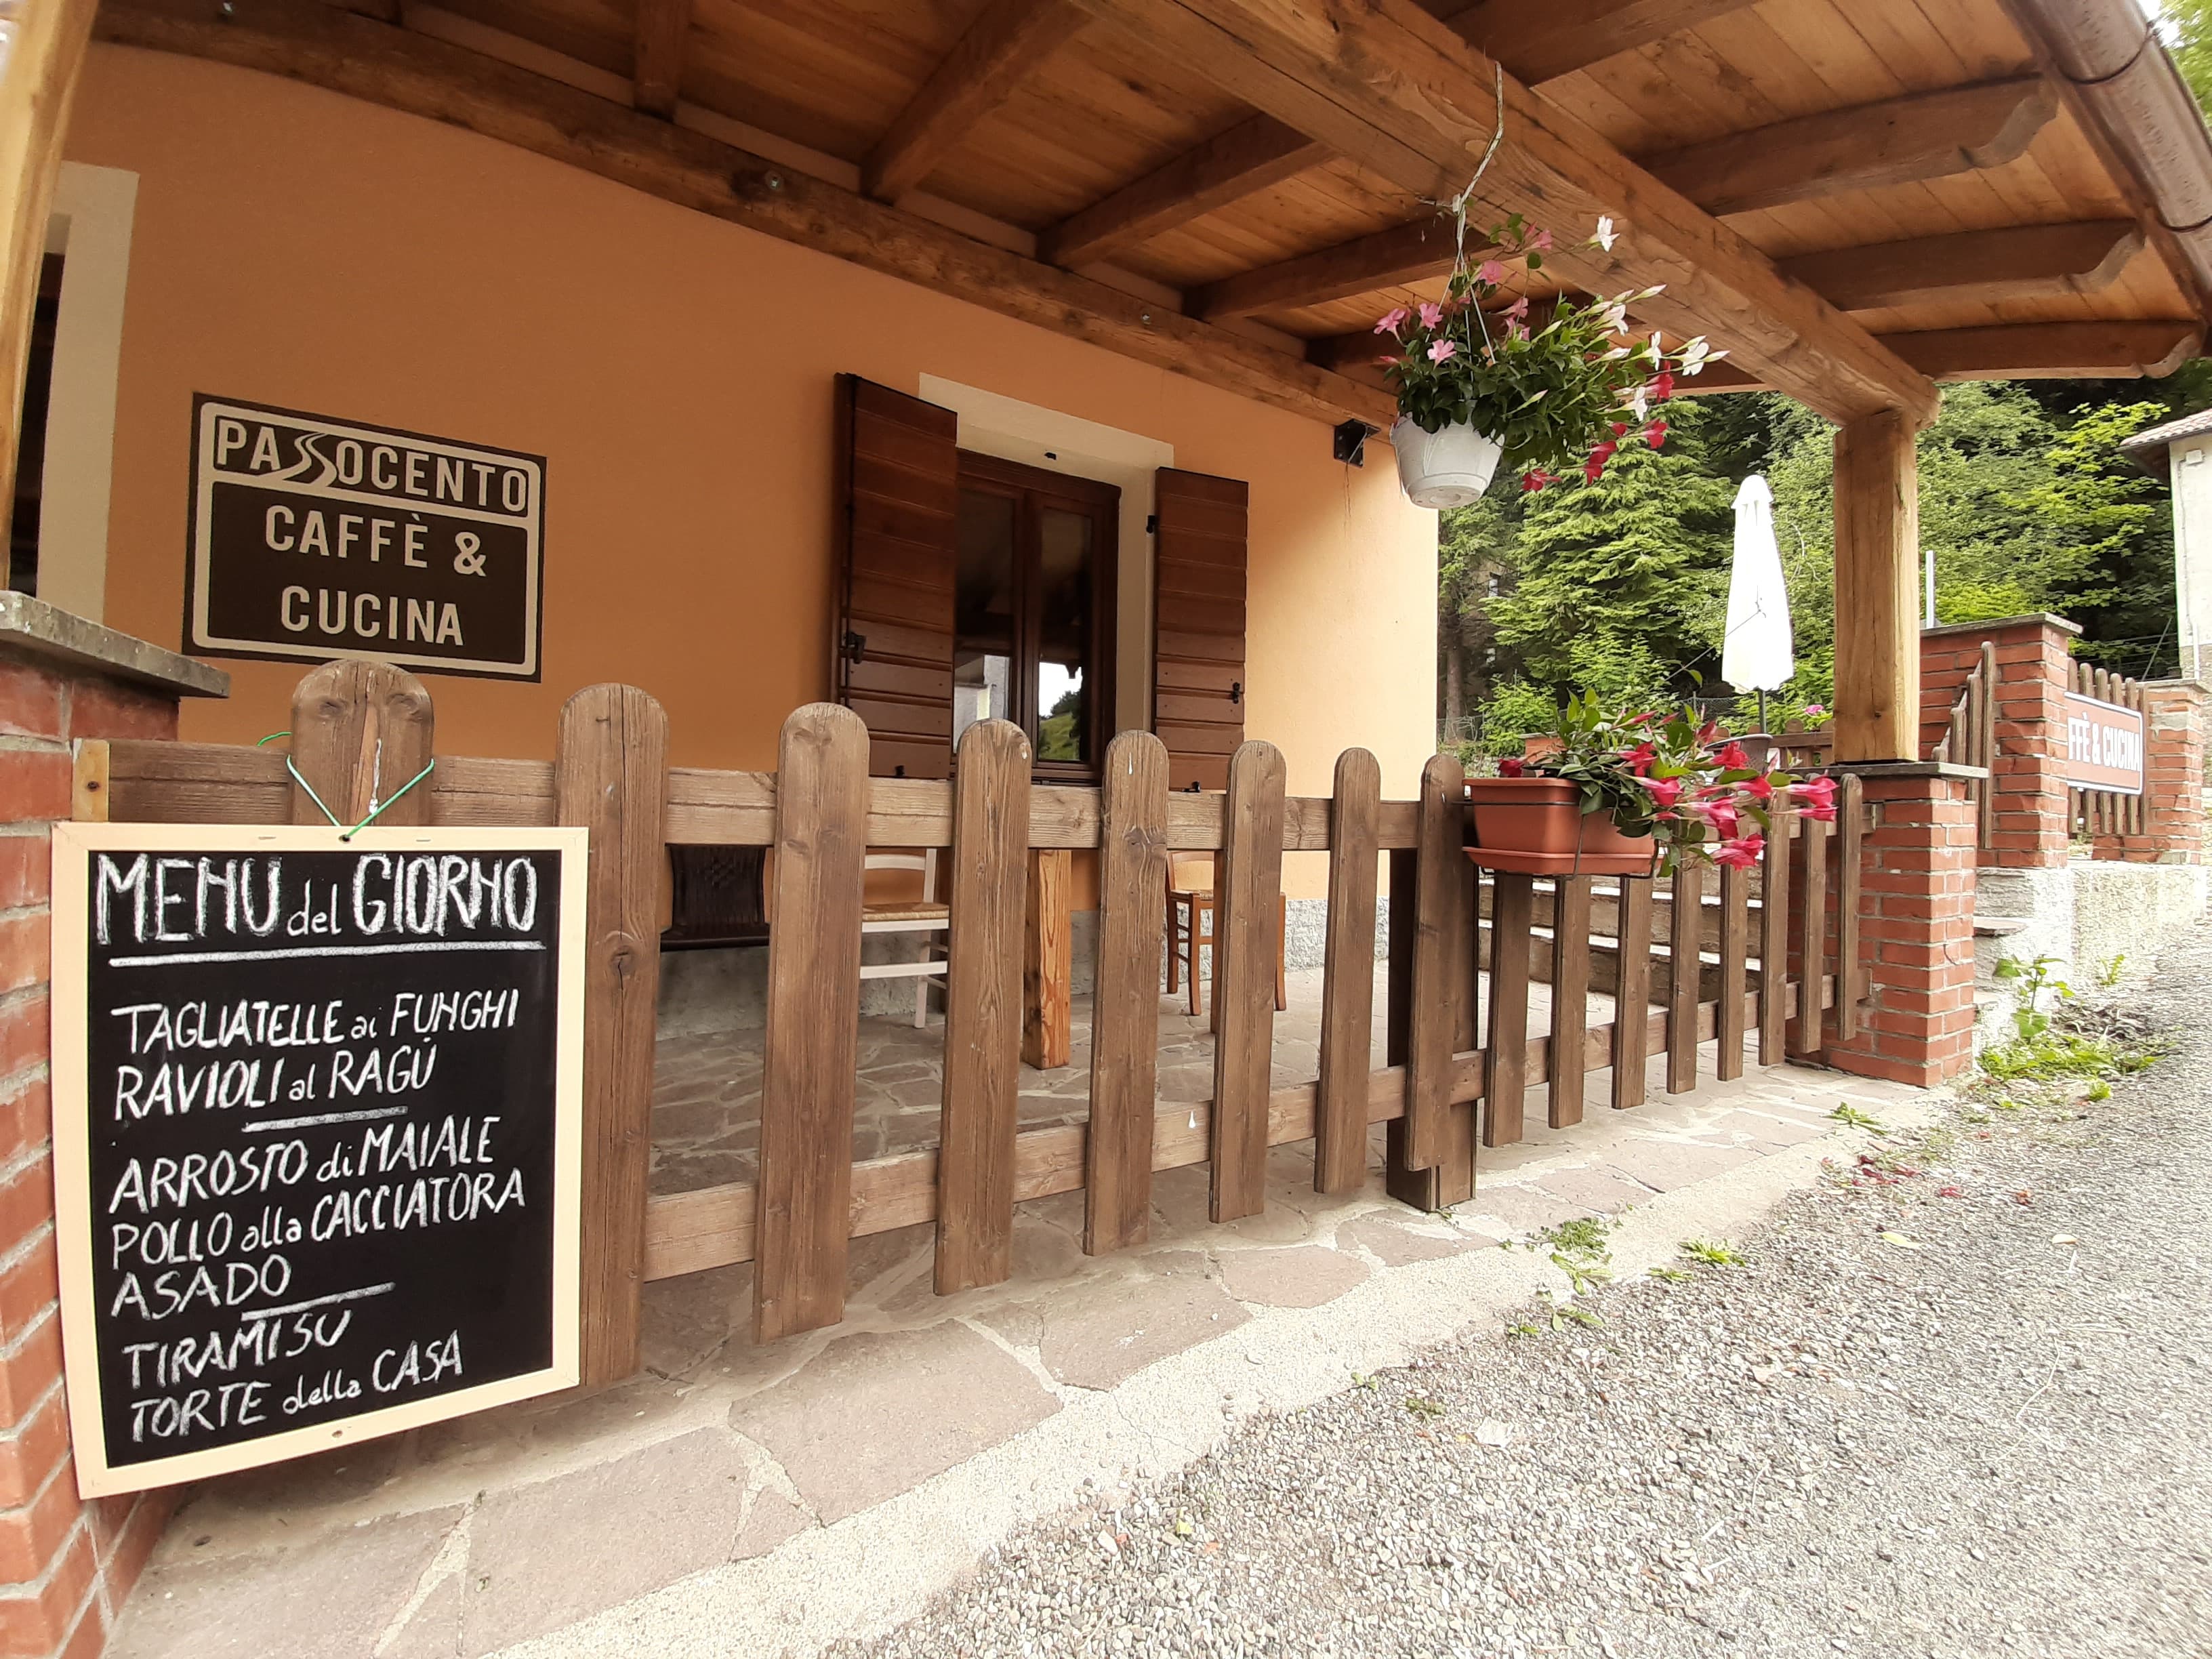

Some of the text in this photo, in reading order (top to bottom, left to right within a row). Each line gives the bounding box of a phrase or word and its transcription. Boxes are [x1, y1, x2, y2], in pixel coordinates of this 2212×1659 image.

[216, 419, 527, 512] PASSOCENTO
[266, 504, 487, 577] CAFFÈ &
[281, 585, 465, 647] CUCINA
[2068, 712, 2140, 771] FFÈ & CUCINA
[96, 853, 538, 945] MENU del GIORNO
[110, 988, 520, 1054] TAGLIATELLE ai FUNGHI
[115, 1058, 285, 1120] RAVIOLI
[289, 1070, 316, 1101] al
[108, 1115, 500, 1214] ARROSTO di MAIALE
[112, 1167, 526, 1269] POLLO alla CACCIATORA
[110, 1254, 291, 1320] ASADO
[131, 1329, 464, 1442] TORTE della CASA
